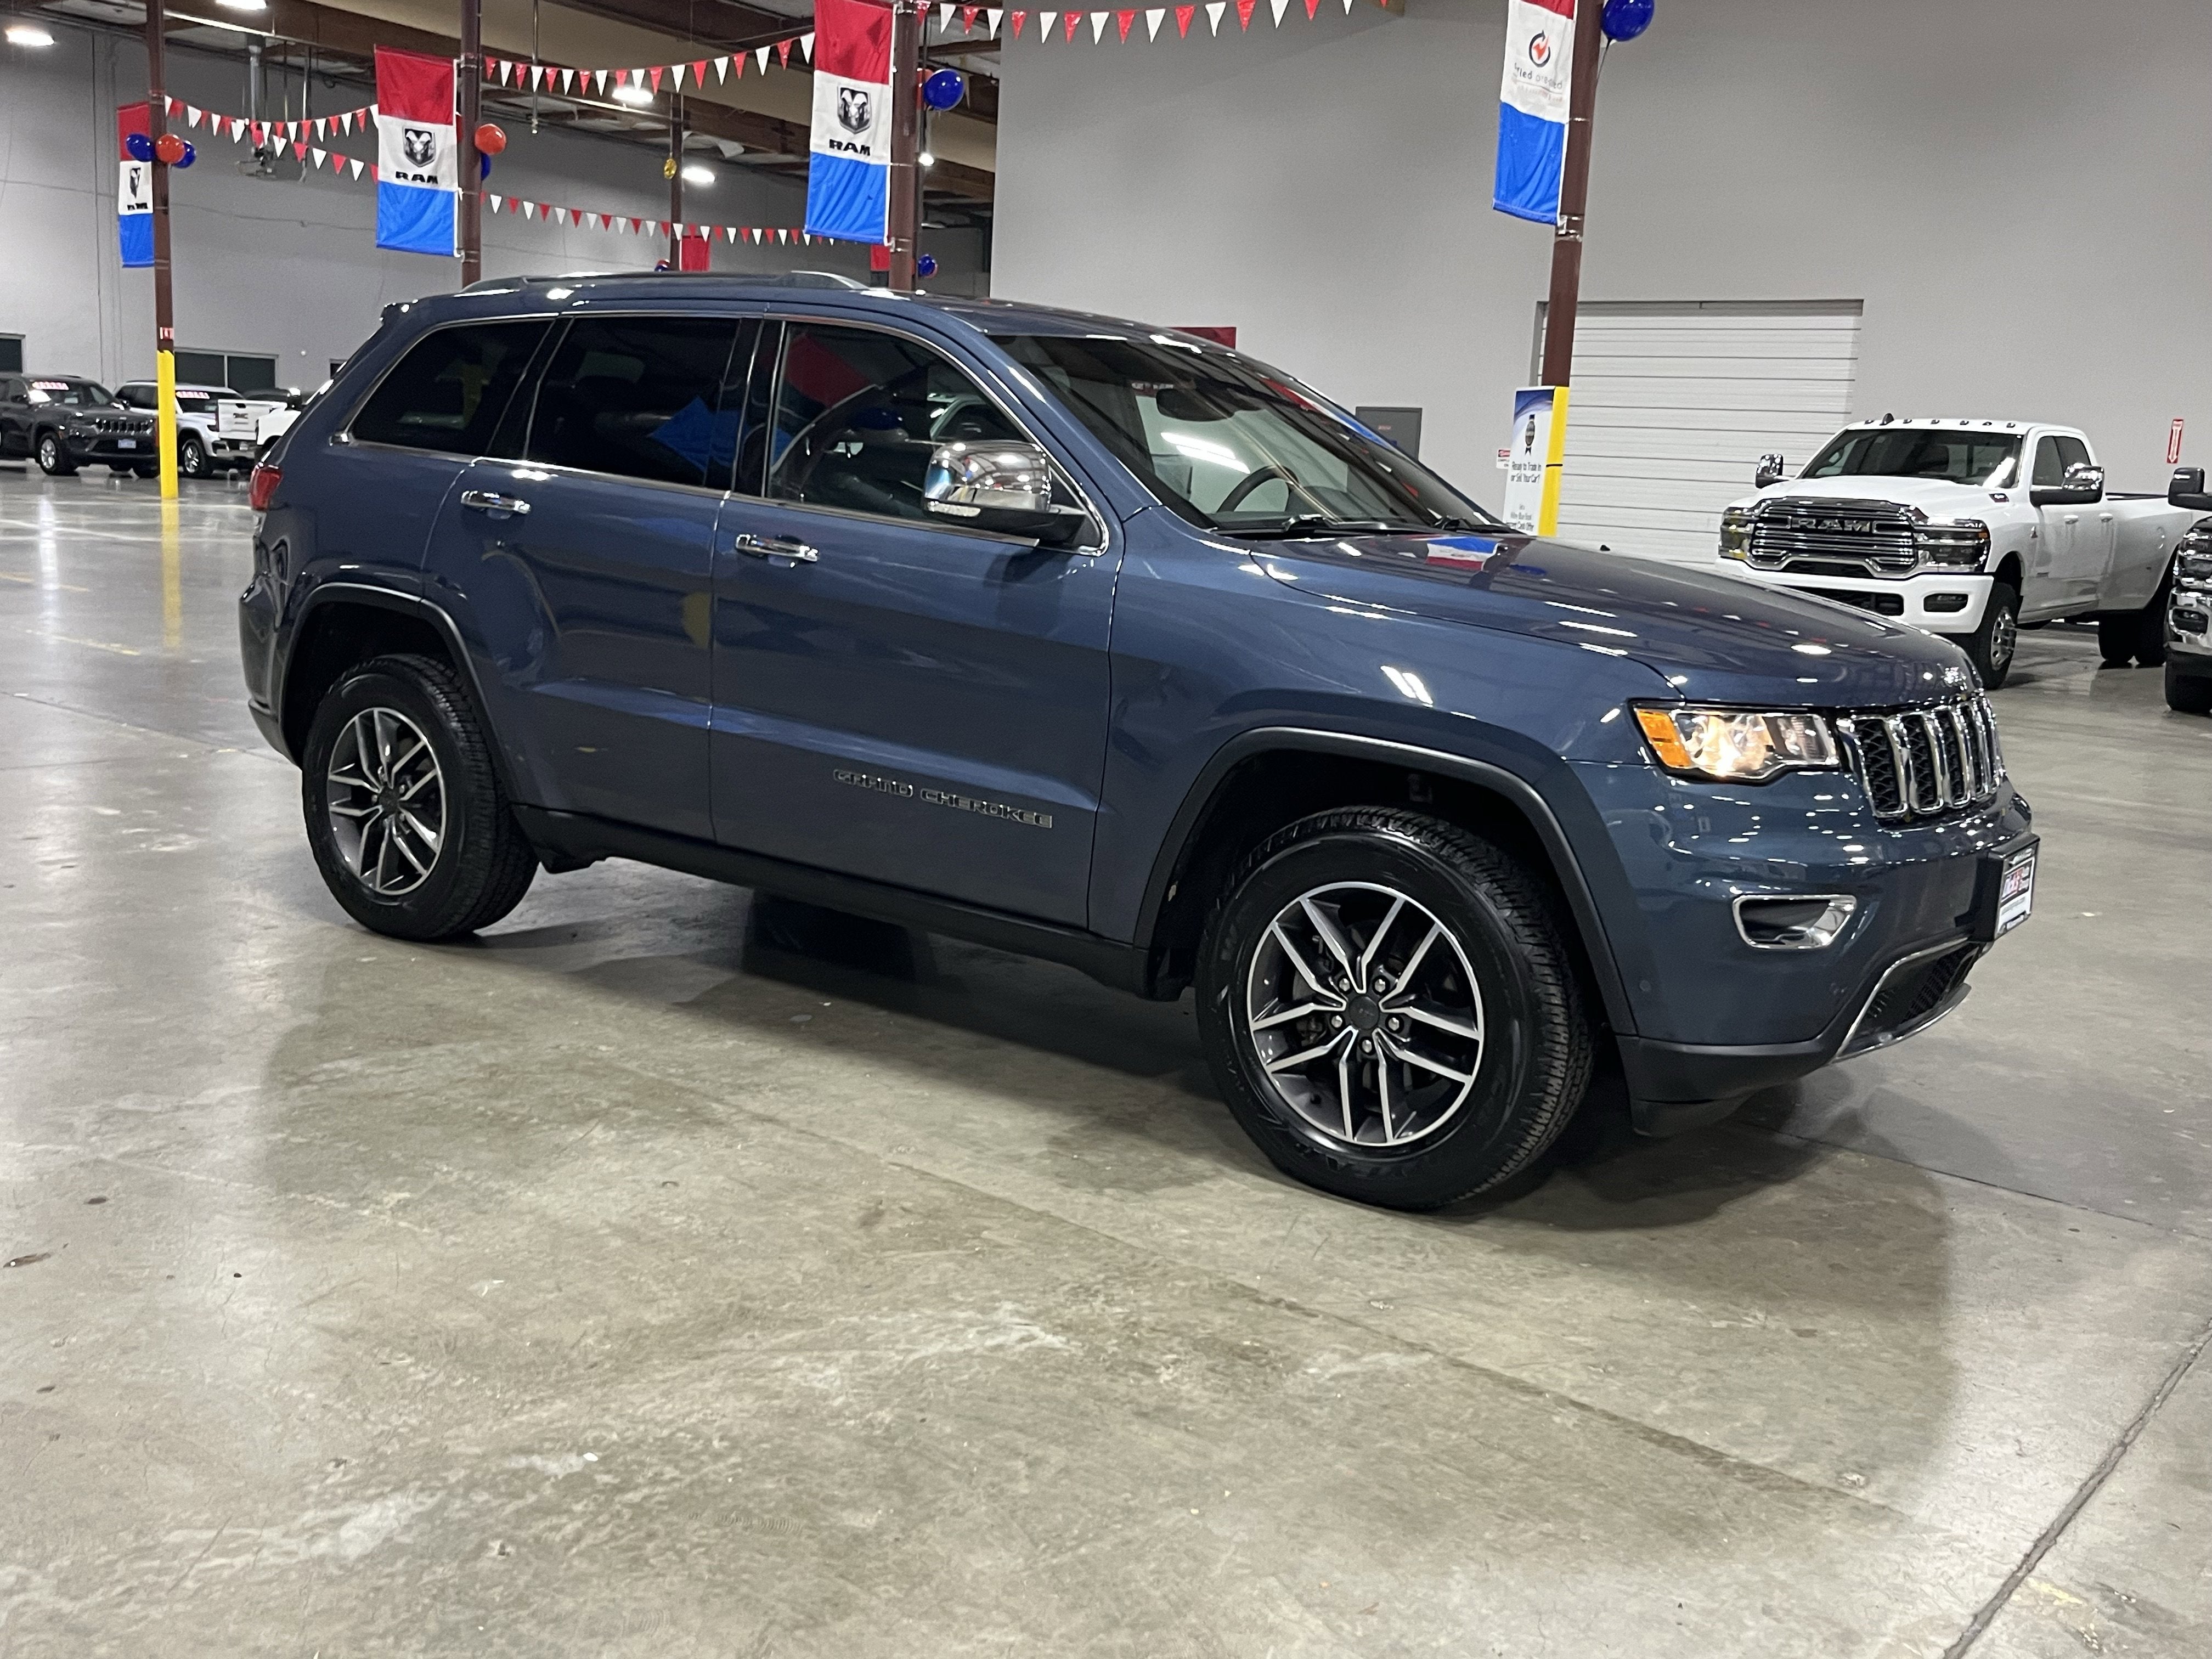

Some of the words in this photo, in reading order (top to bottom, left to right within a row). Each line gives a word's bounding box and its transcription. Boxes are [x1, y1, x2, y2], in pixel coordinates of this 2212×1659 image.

[829, 139, 871, 156] RAM
[395, 171, 438, 185] RAM
[1792, 517, 1870, 532] RAM
[833, 769, 913, 798] GRAND
[921, 788, 1053, 829] CHEROKEE
